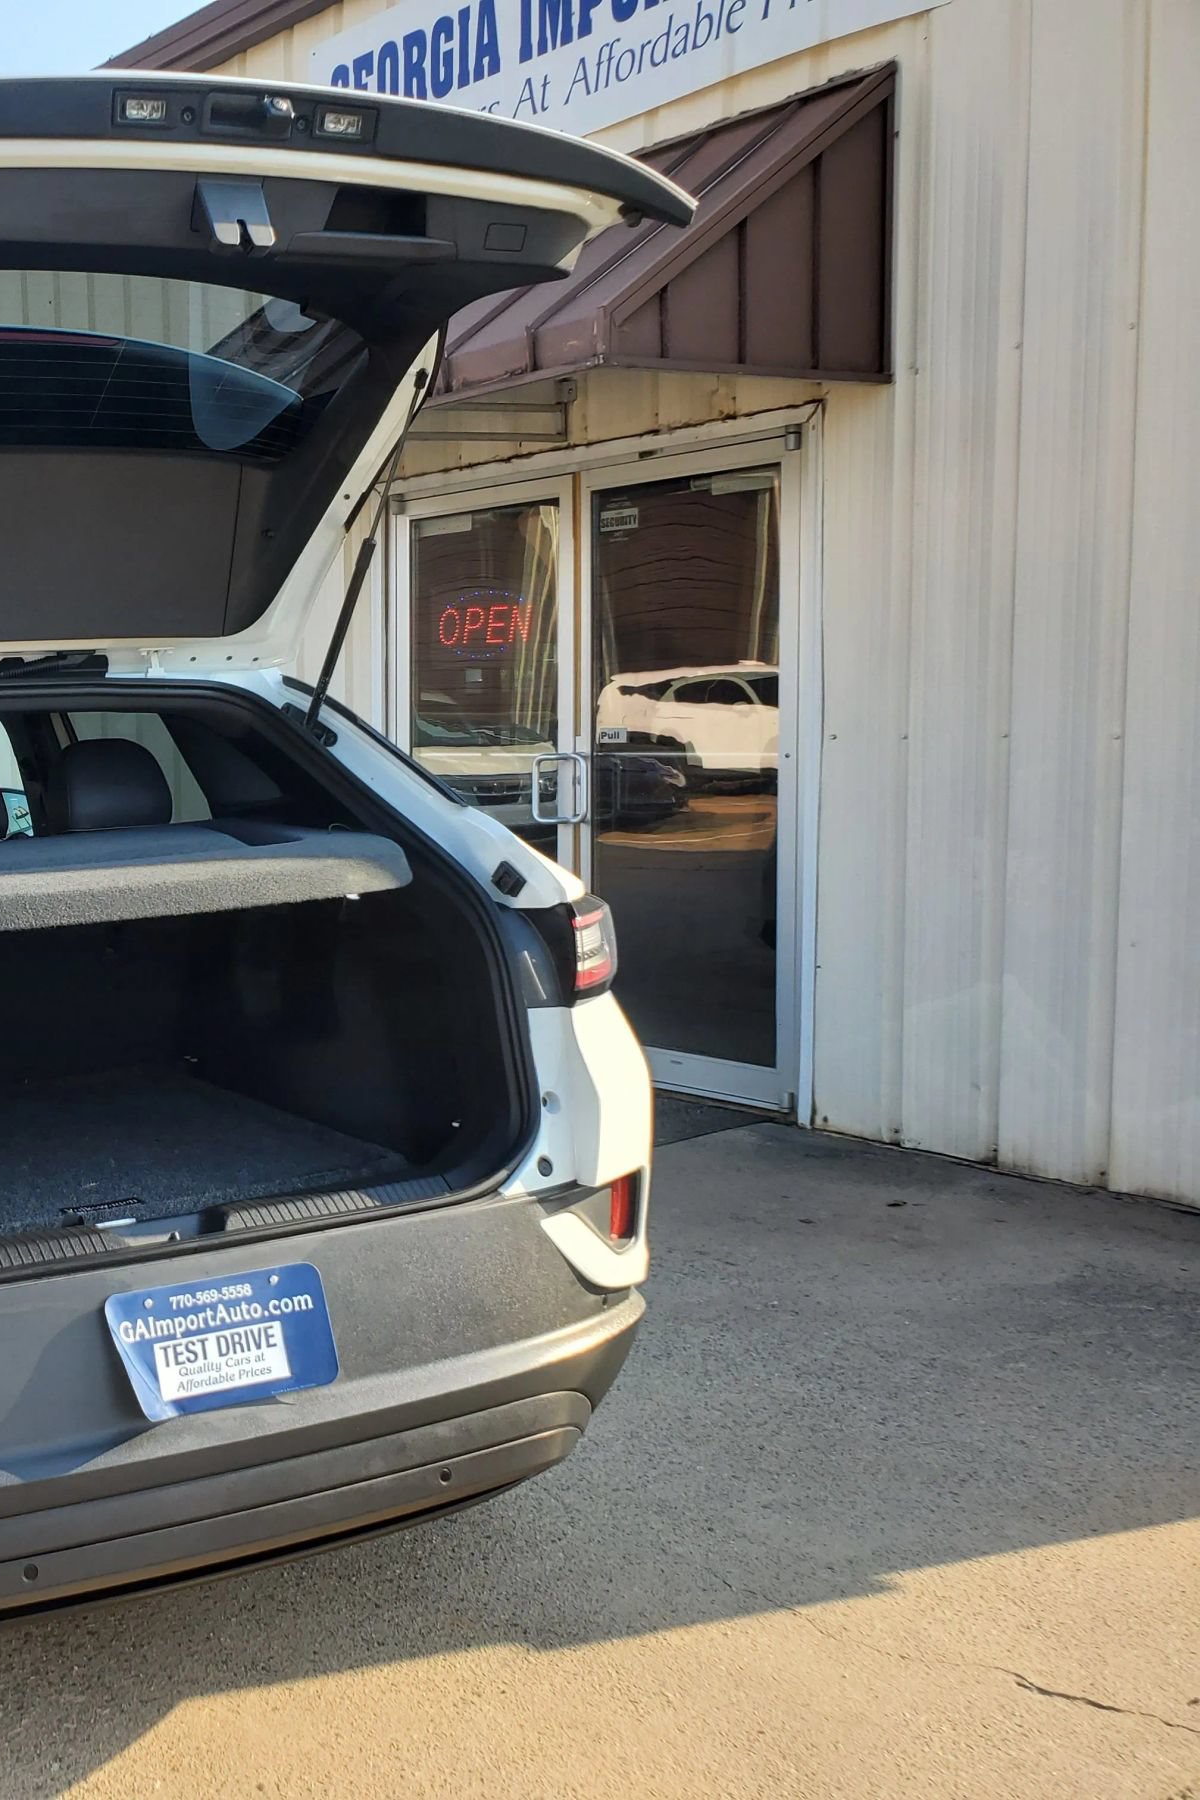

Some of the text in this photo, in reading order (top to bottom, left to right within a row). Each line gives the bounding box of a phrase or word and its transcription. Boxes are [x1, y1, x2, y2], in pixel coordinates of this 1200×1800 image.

[512, 0, 745, 119] At Affordable
[440, 604, 532, 645] OPEN
[600, 731, 620, 740] Pull
[169, 1283, 253, 1311] 770-569-5558
[119, 1293, 315, 1344] GAImportAuto.com
[159, 1325, 278, 1368] TEST DRIVE
[176, 1365, 273, 1393] Affordable Prices
[178, 1351, 266, 1378] Quality Cars at
